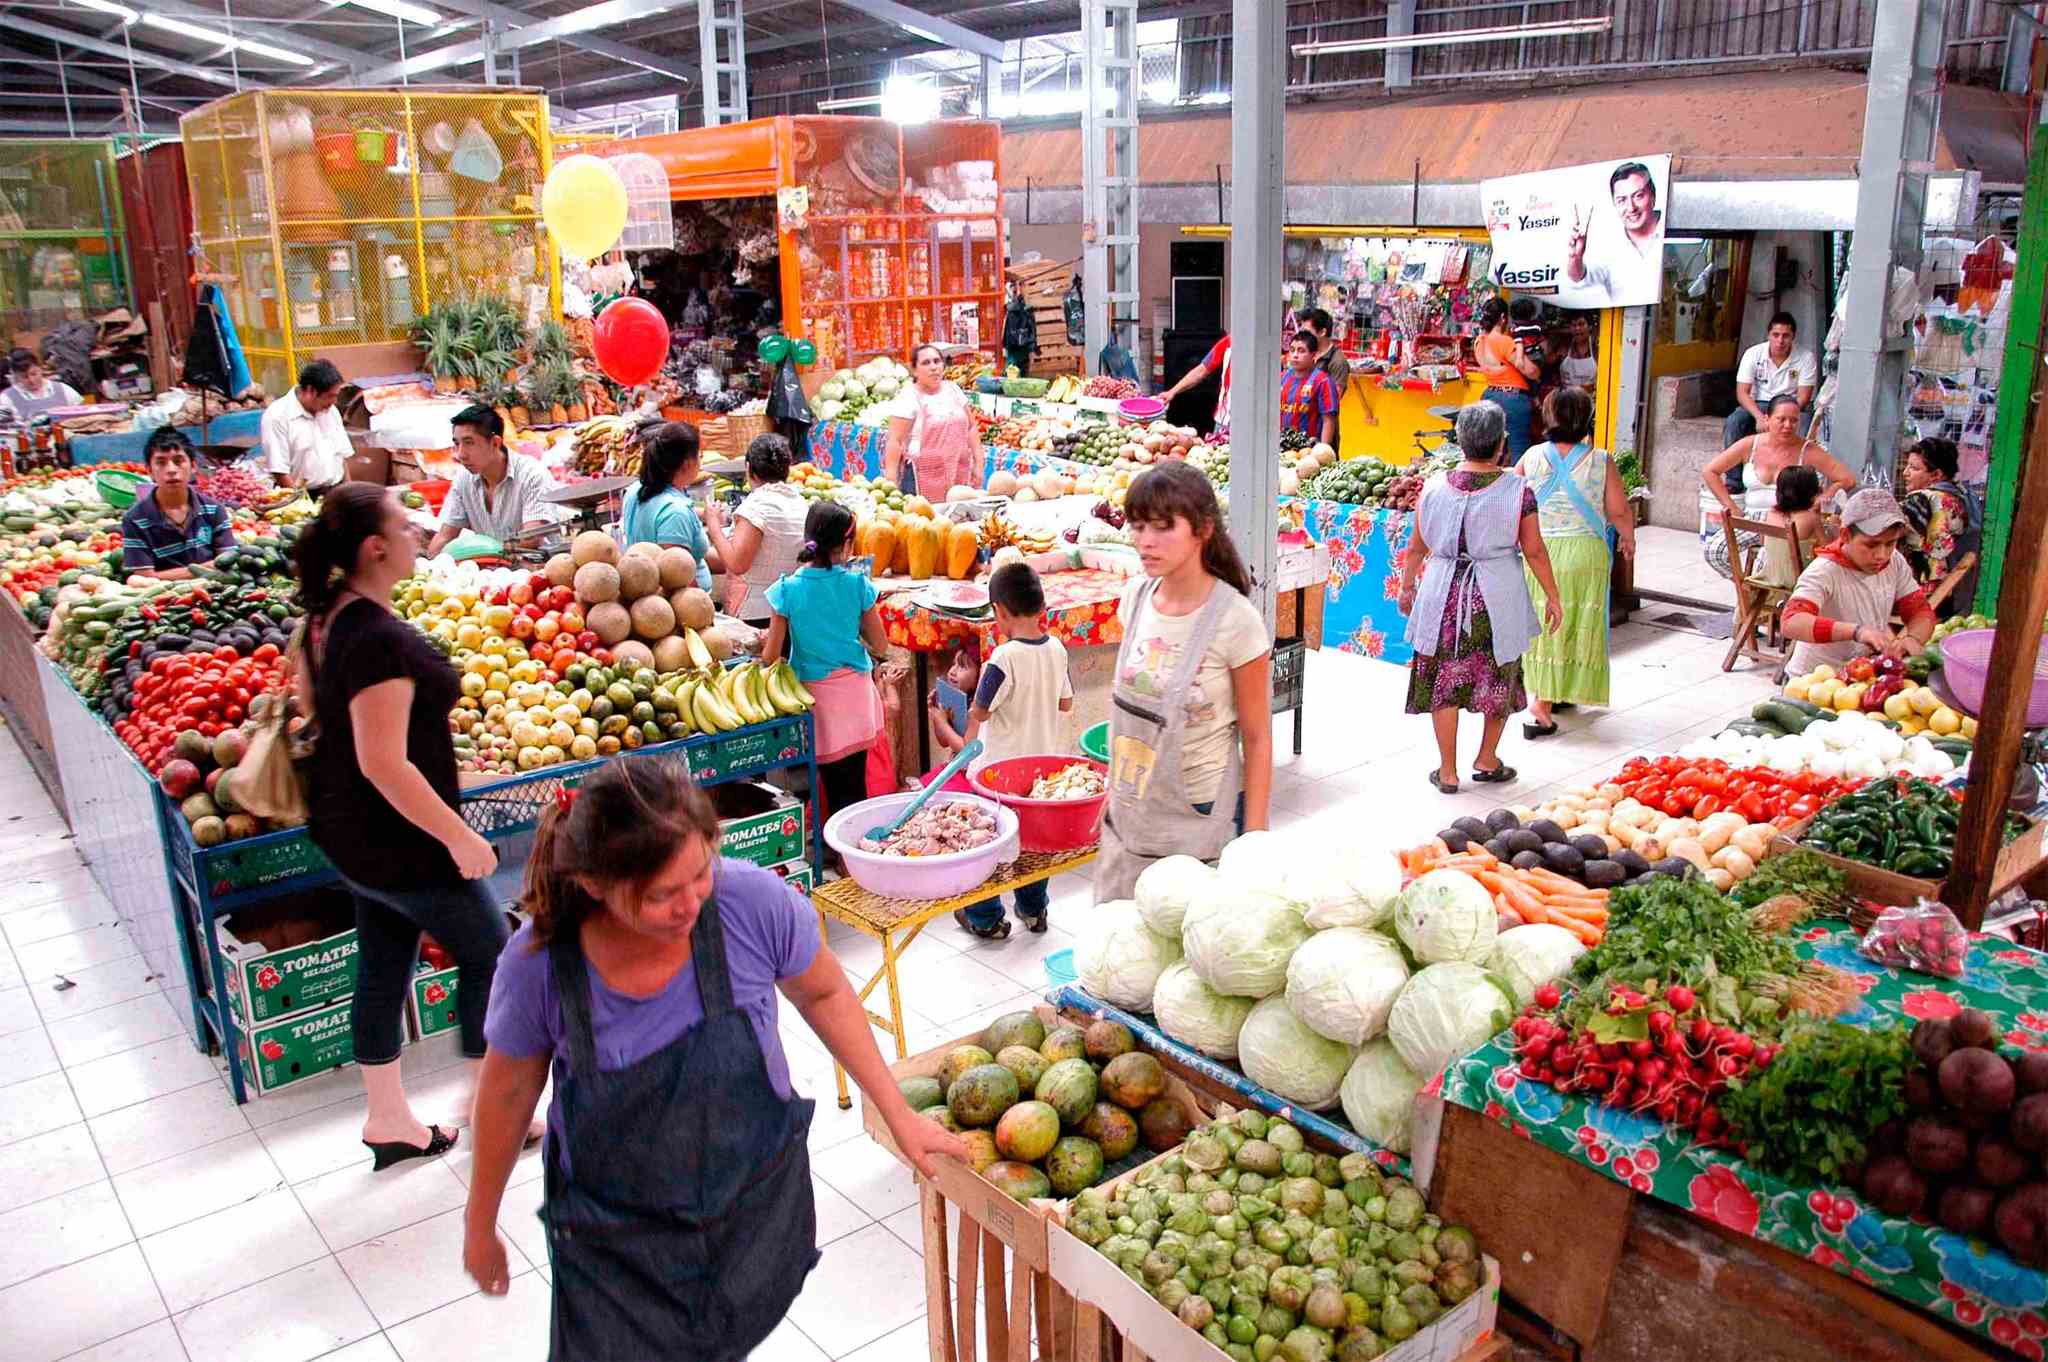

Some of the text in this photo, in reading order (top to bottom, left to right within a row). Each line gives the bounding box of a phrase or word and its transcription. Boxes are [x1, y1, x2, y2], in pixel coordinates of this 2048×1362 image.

[1518, 215, 1561, 231] Yassir
[1494, 262, 1560, 284] Yassir
[722, 820, 781, 845] TOMATES
[283, 940, 359, 974] TOMATES
[302, 960, 347, 979] SELECTOS
[291, 1010, 351, 1039] TOMAT
[310, 1023, 351, 1043] SELECTO
